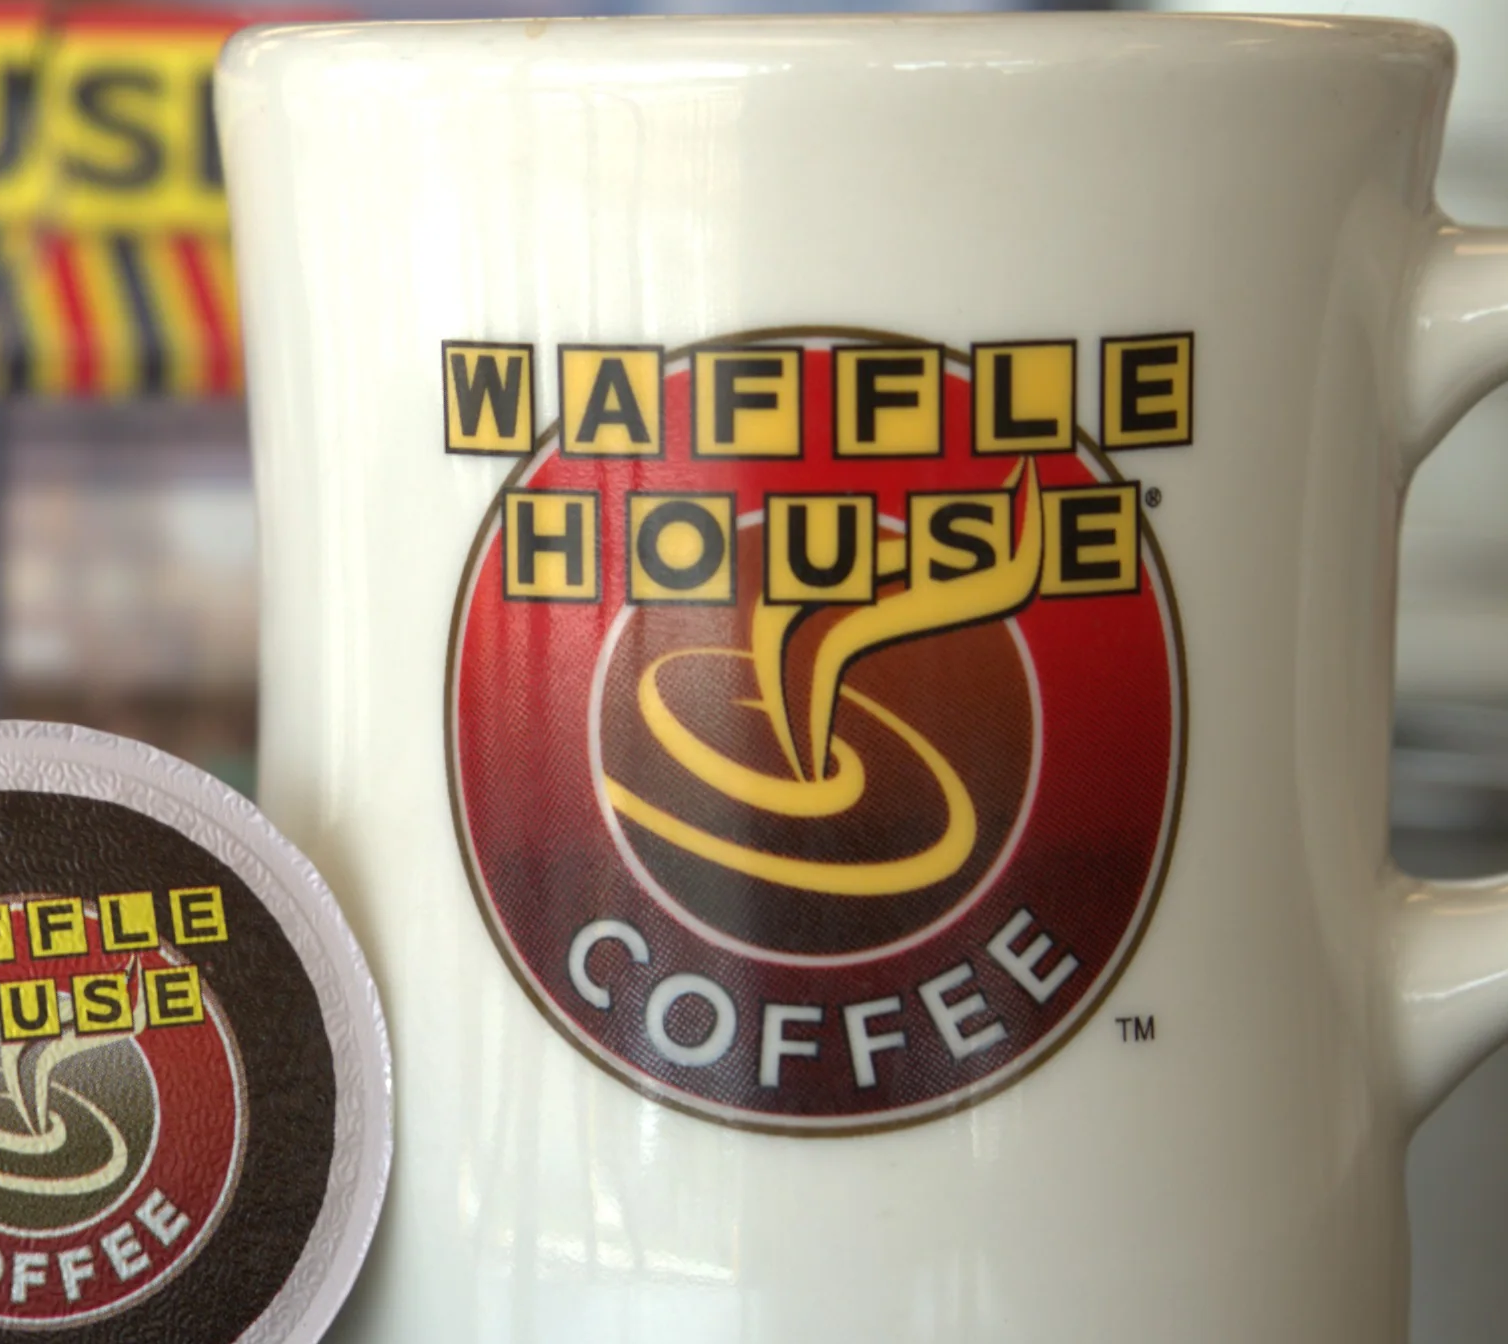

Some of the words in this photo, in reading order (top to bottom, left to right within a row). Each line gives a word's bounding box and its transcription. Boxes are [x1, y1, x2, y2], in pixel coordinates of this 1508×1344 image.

[446, 344, 1180, 446] WAFFLE
[567, 906, 1081, 1089] COFFEE
[1115, 1015, 1155, 1043] TM
